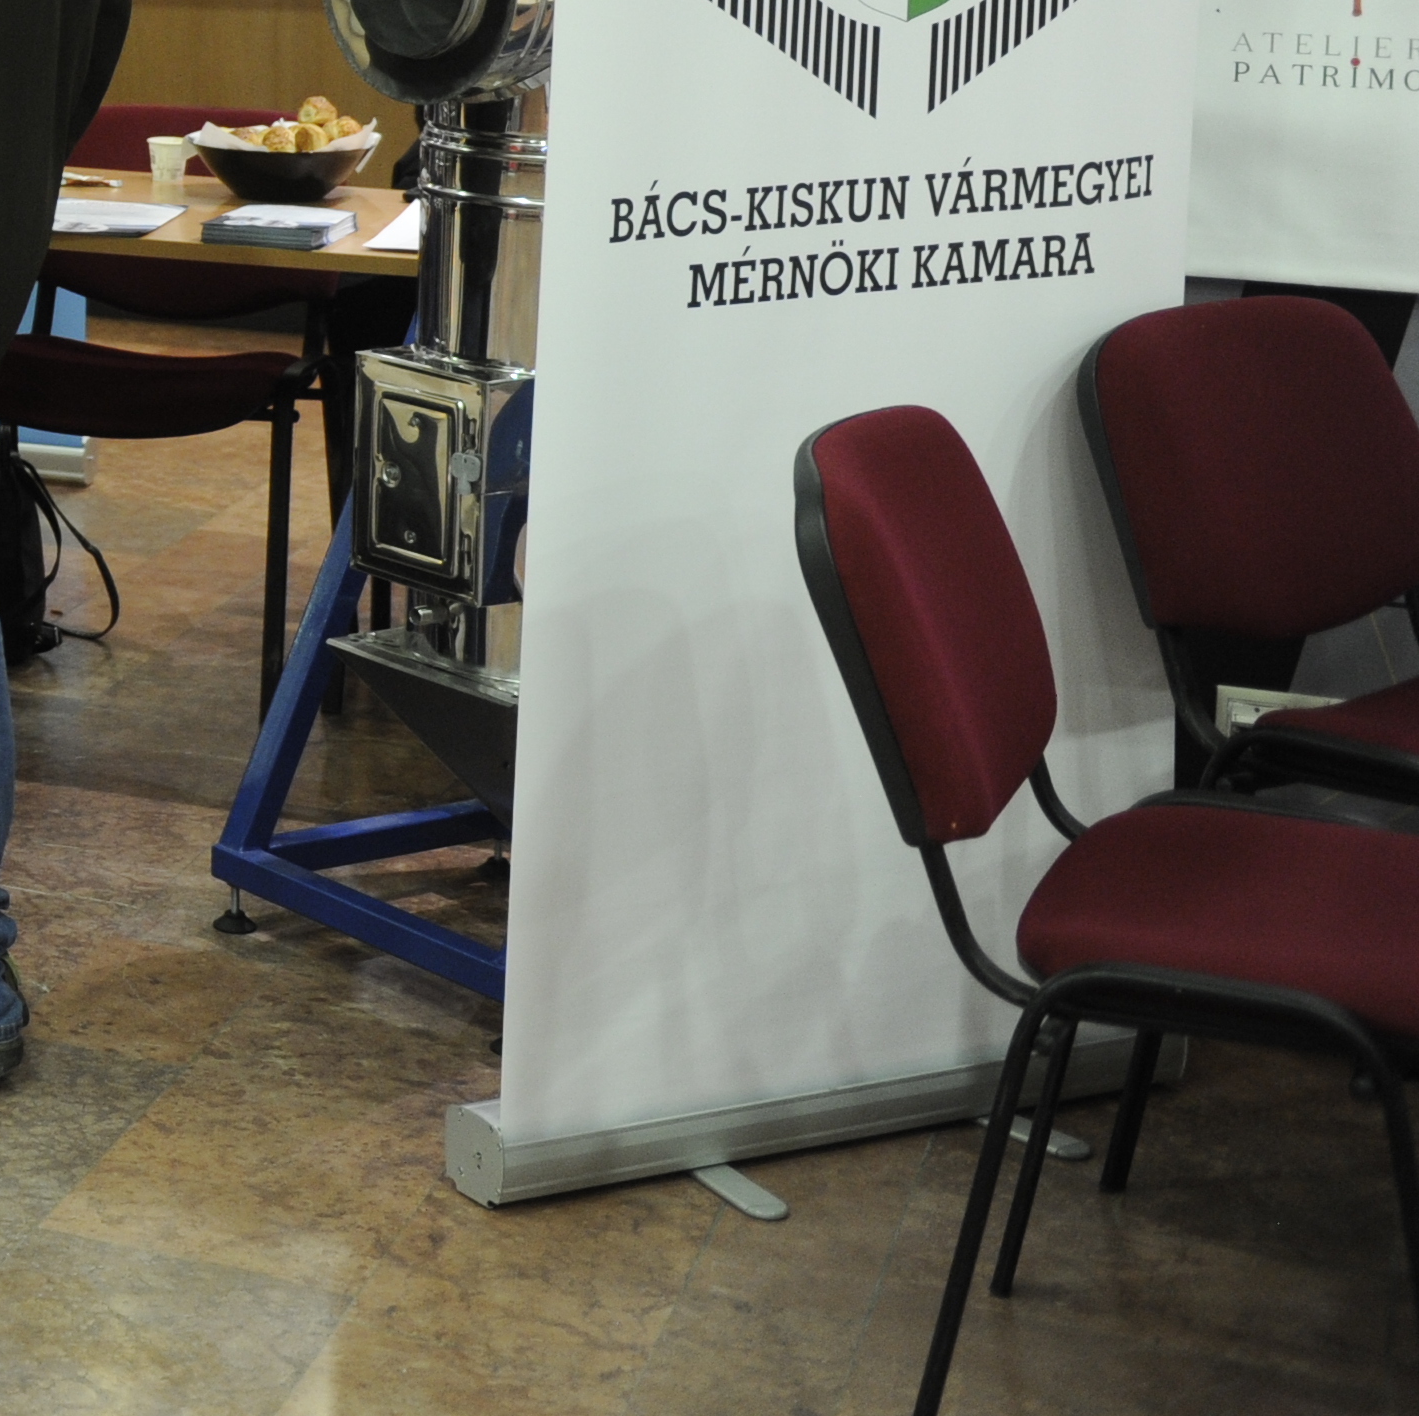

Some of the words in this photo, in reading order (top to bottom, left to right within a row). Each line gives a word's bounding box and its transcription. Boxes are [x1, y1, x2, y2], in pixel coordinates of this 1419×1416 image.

[609, 180, 910, 243] BÁCS-KISKUN
[925, 154, 1155, 217] VÁRMEGYEI
[687, 239, 899, 308] MÉRNÖKI
[911, 232, 1095, 289] KAMARA
